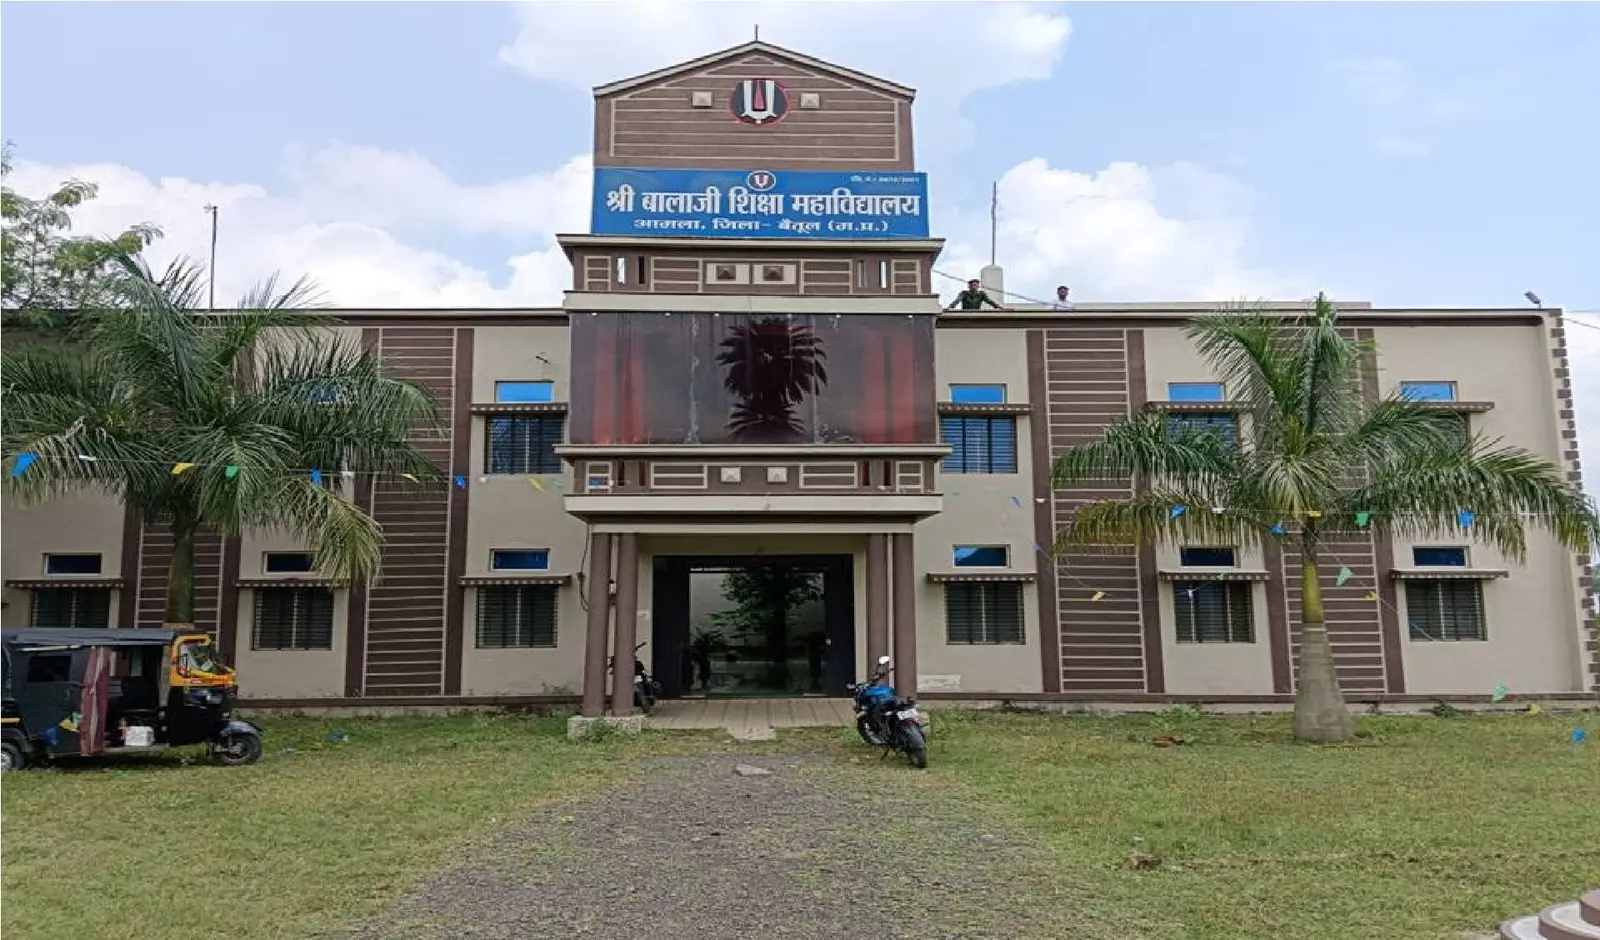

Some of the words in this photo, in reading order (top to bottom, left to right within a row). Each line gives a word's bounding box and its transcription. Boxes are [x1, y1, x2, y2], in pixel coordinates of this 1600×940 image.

[606, 184, 636, 212] श्री
[642, 186, 722, 214] बालाजी
[728, 186, 784, 215] शिक्षा
[790, 187, 921, 216] महाविद्यालय
[634, 219, 706, 230] आमला,
[778, 217, 820, 233] बैतूल
